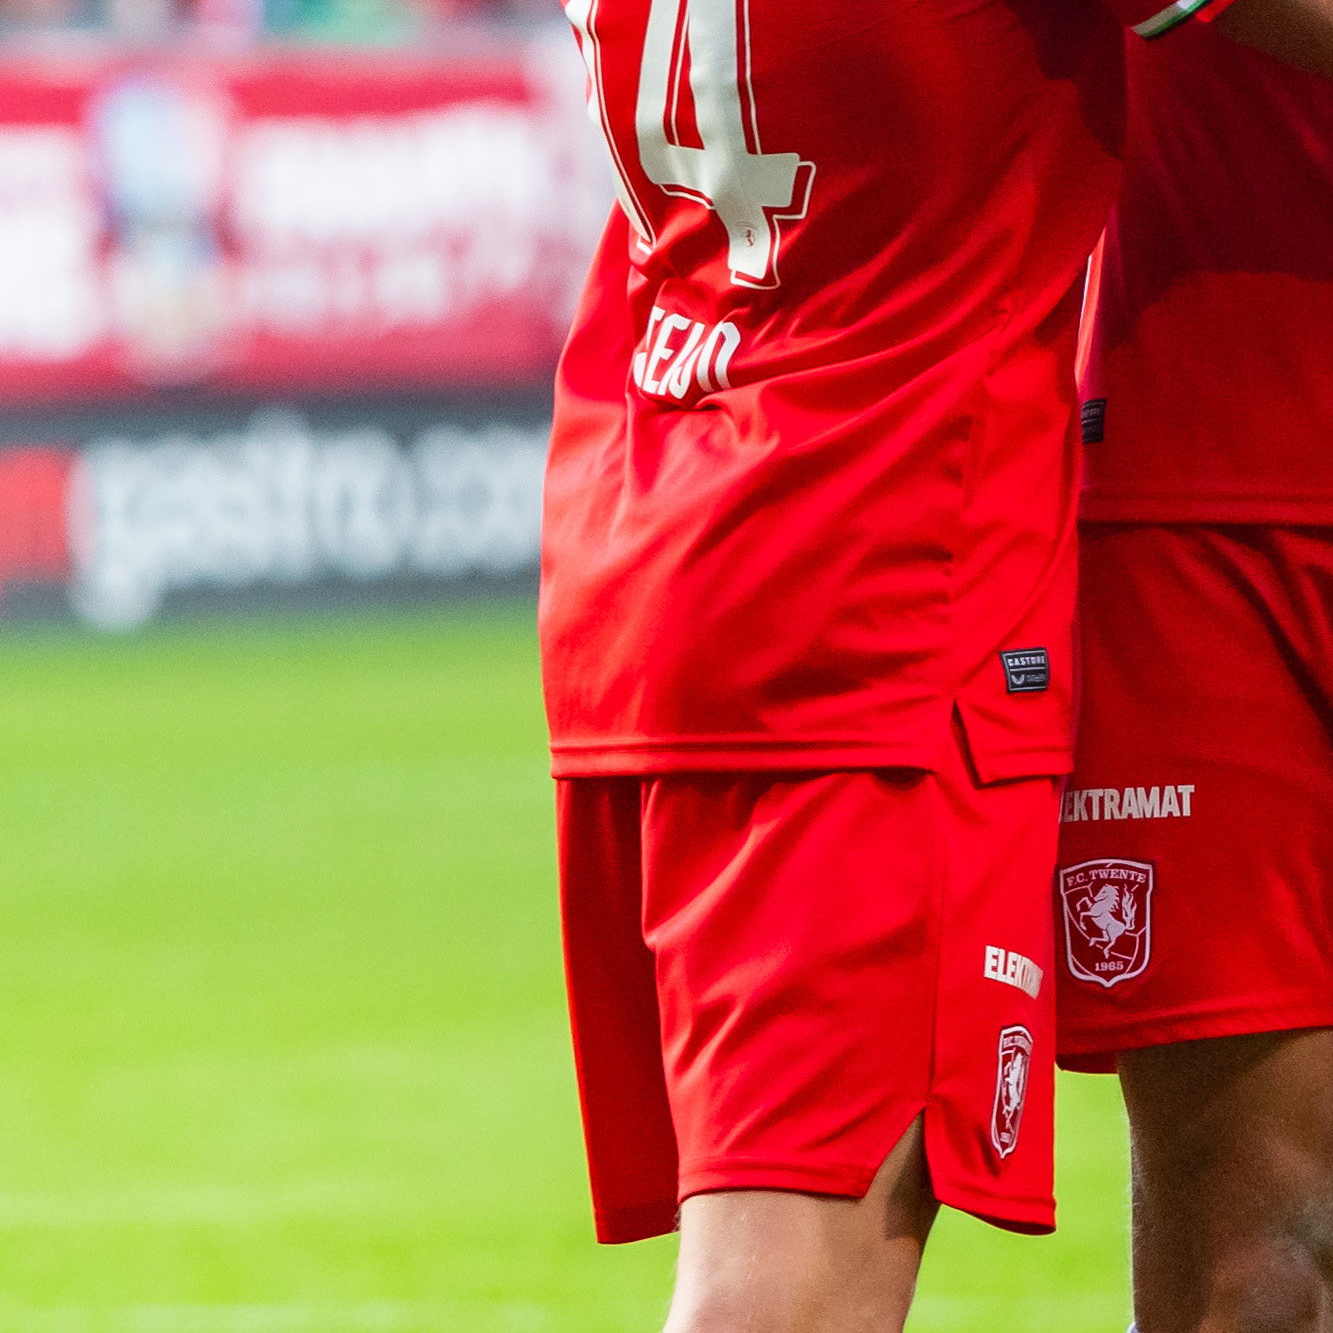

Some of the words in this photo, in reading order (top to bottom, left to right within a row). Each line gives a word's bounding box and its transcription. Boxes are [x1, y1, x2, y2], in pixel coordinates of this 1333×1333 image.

[1063, 784, 1195, 822] EKTRAMAT
[1089, 869, 1146, 883] TWENTE
[1094, 961, 1124, 971] 1965
